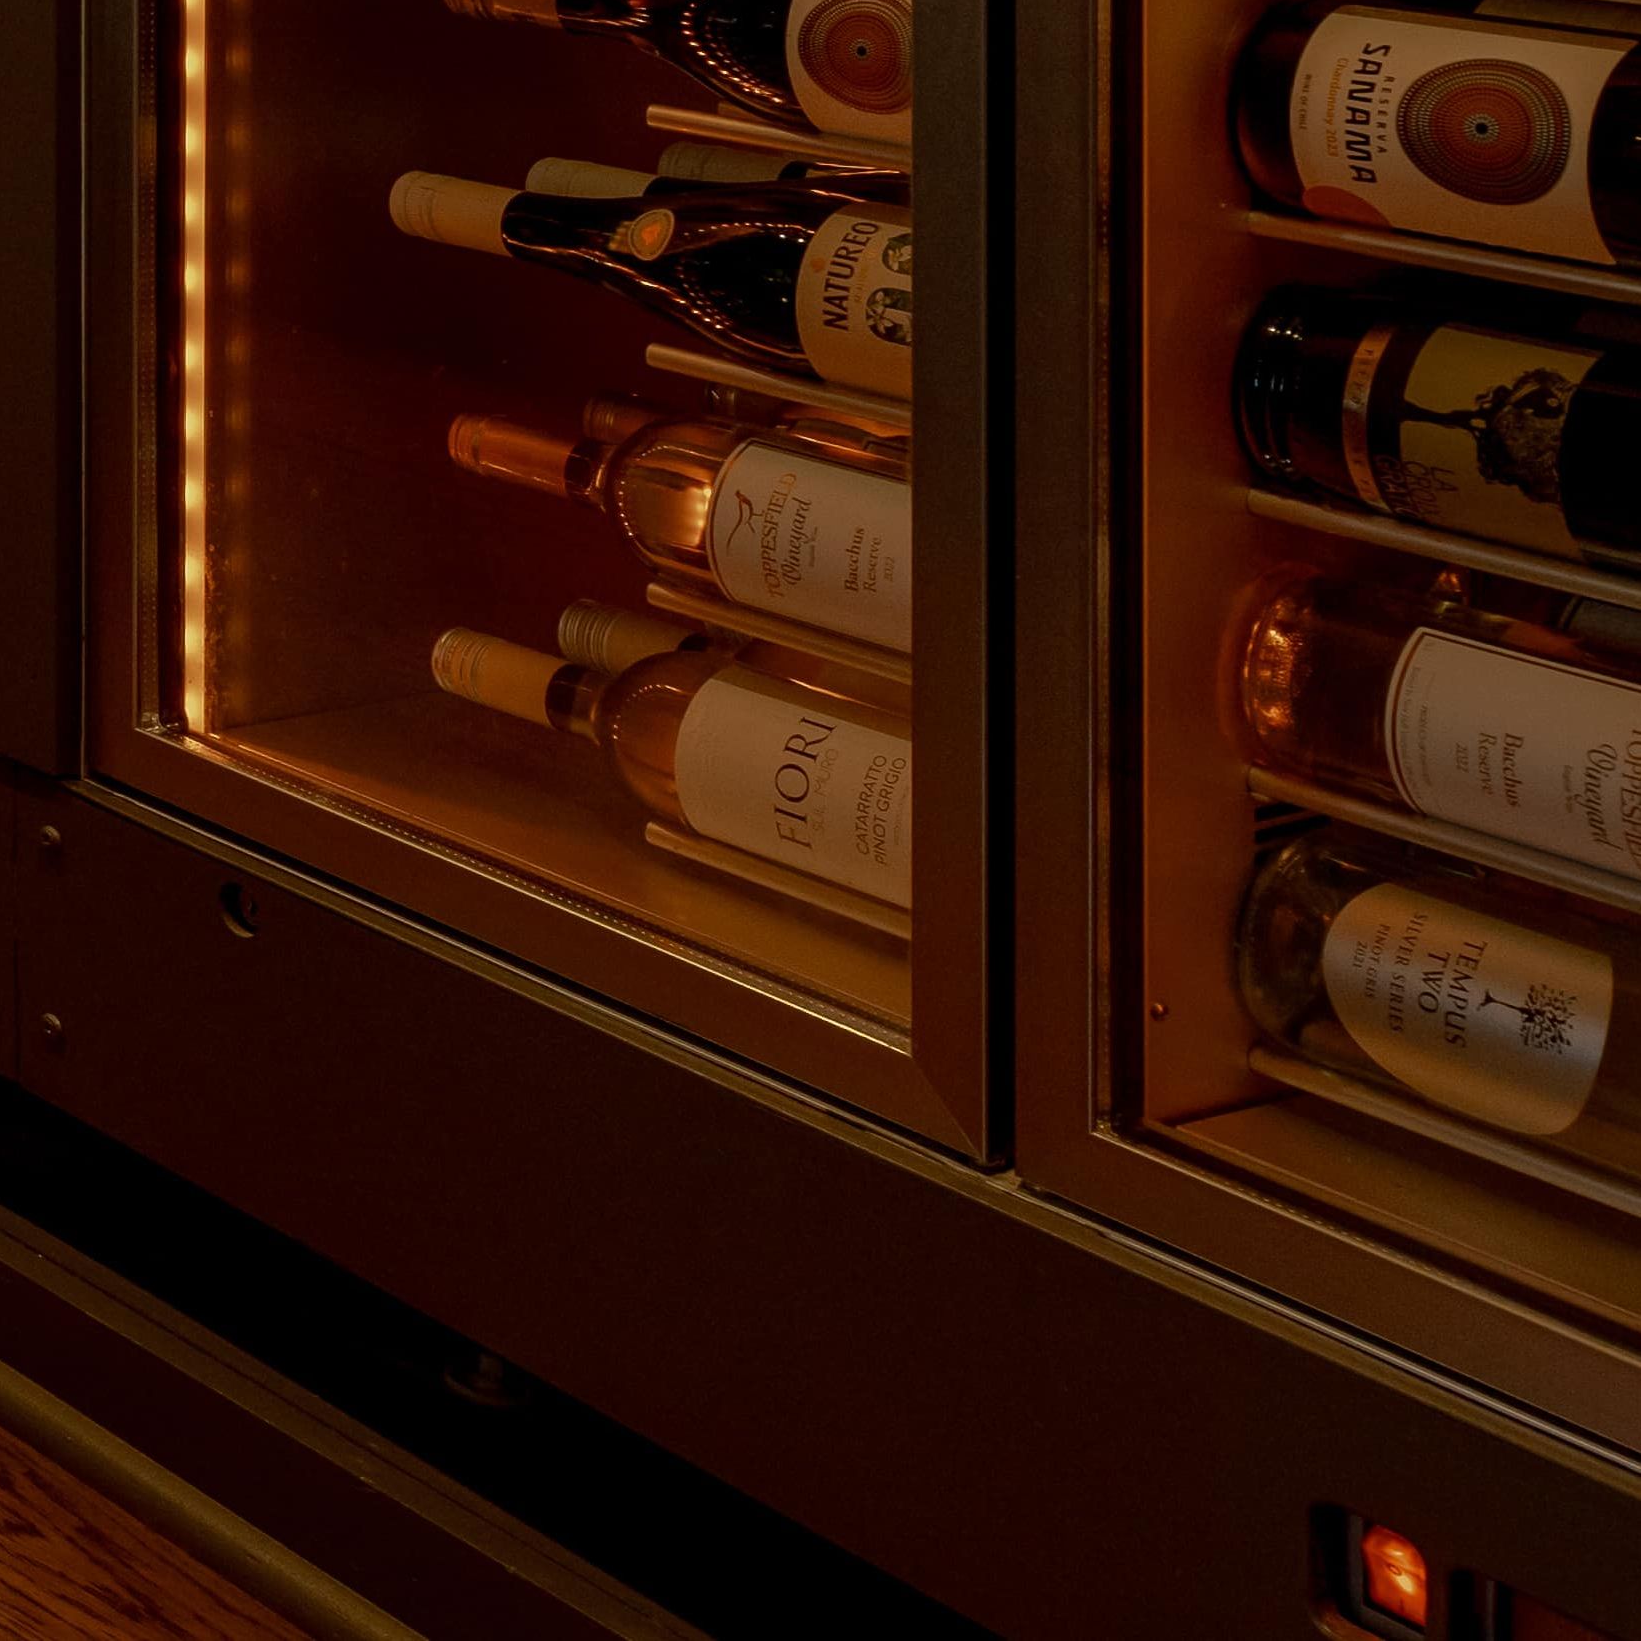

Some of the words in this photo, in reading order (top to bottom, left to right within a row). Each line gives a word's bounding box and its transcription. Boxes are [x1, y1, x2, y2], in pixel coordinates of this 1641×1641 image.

[1324, 57, 1348, 126] Chardonnay
[1345, 43, 1389, 183] SANAMA
[1375, 76, 1394, 154] RESERVA
[822, 219, 878, 331] NATUREO
[1430, 466, 1458, 492] LA
[788, 497, 811, 584] Vineyard
[844, 525, 865, 592] Bacchus
[863, 536, 881, 591] Reserve
[770, 716, 835, 848] FIORI
[878, 756, 907, 812] GRIGIO
[1479, 732, 1496, 795] Reserve
[1501, 733, 1523, 807] Bacchus
[854, 753, 887, 854] CATARRATTO
[1575, 746, 1620, 850] Vineyard
[875, 815, 885, 864] PINOT
[1367, 923, 1390, 963] PINOT
[1395, 911, 1425, 967] SILVER
[1388, 972, 1405, 1033] SERIES
[1416, 947, 1450, 1015] TWO
[1443, 937, 1487, 1046] TEMPUS
